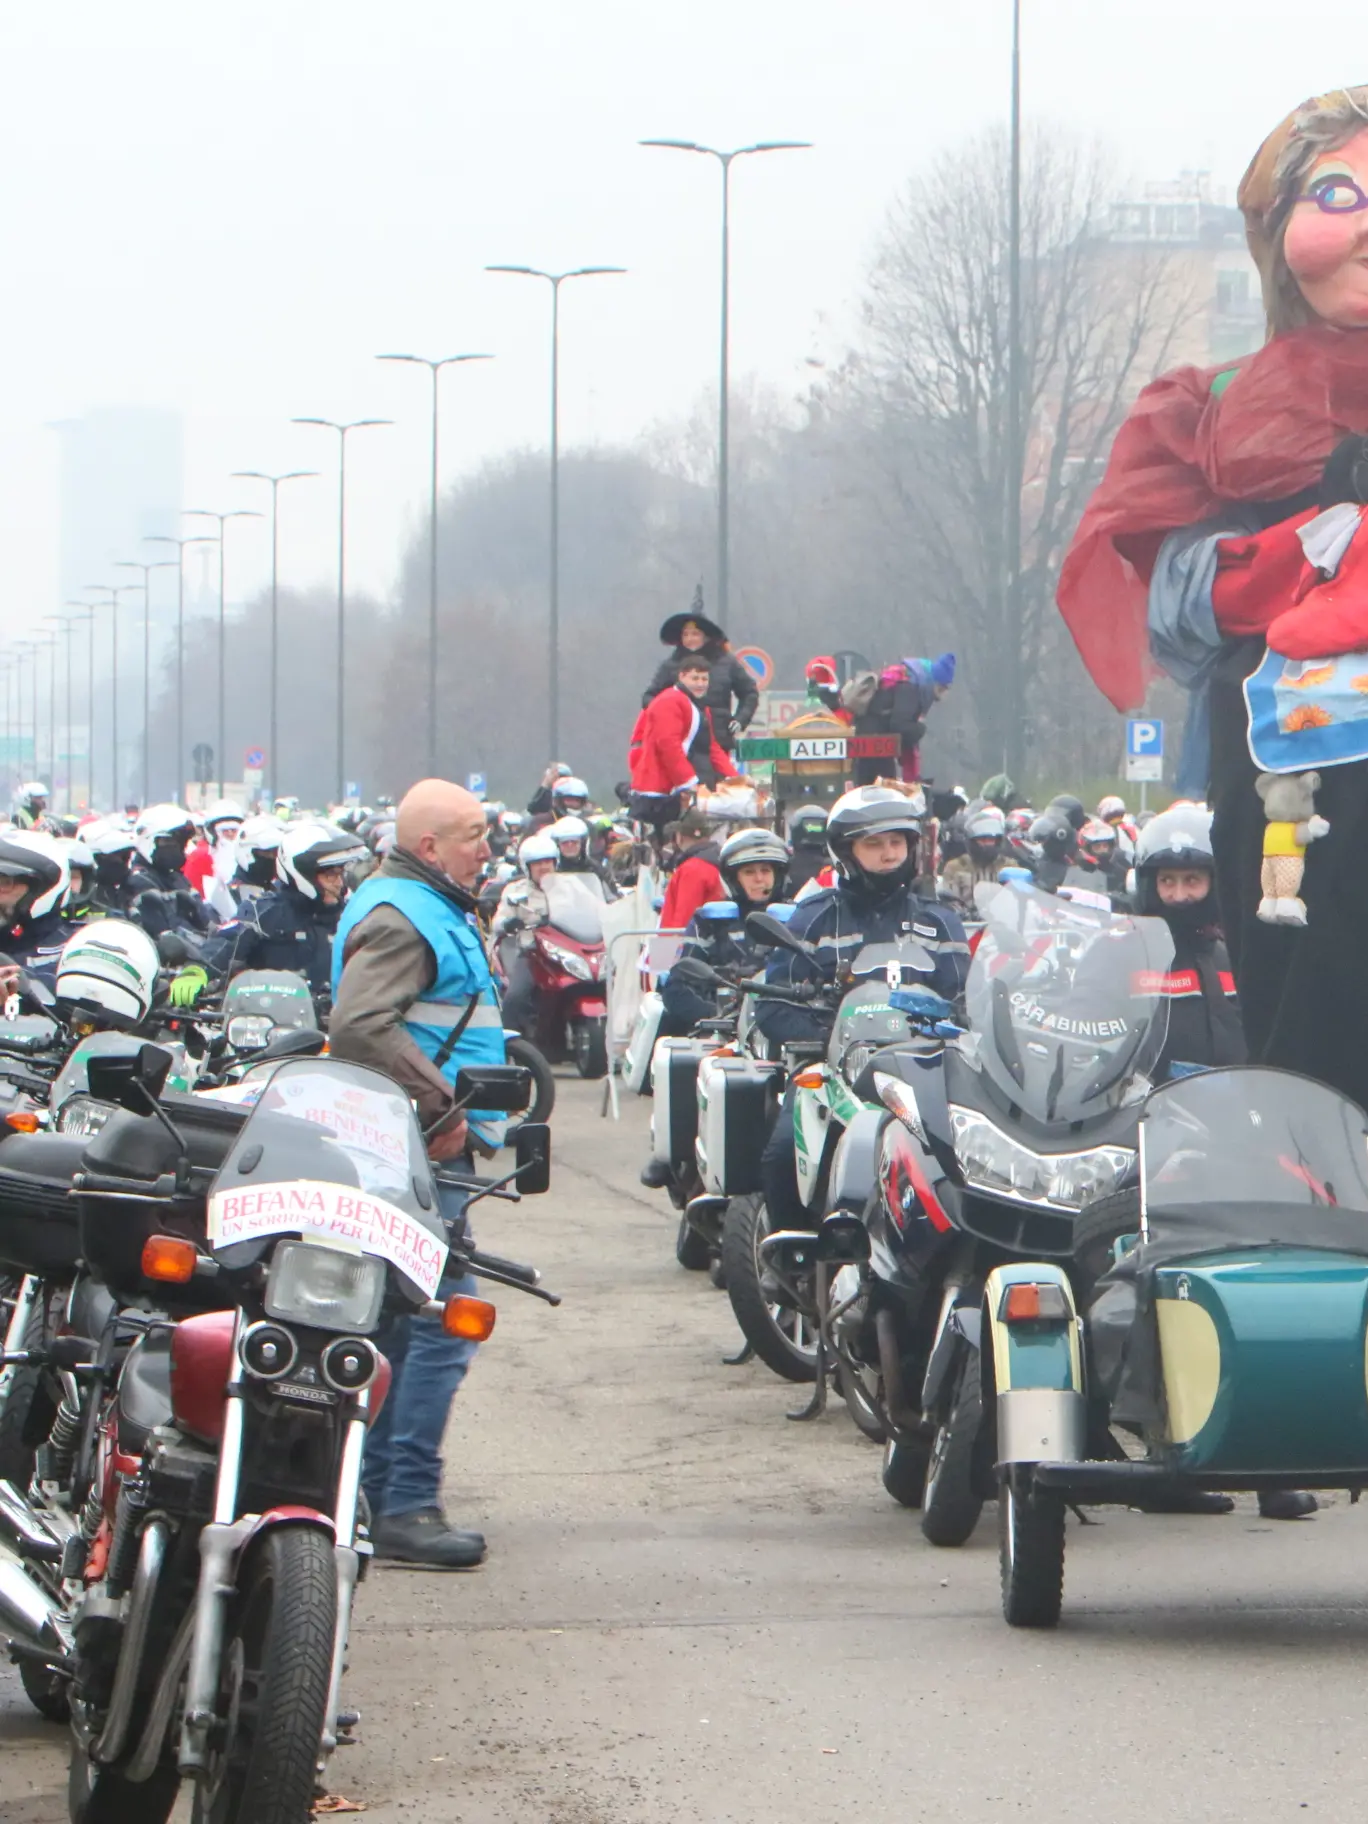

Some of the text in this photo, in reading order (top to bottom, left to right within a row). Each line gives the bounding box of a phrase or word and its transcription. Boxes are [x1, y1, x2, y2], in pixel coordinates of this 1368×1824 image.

[1133, 723, 1156, 753] P
[1010, 992, 1128, 1036] CARABINIERI
[221, 1212, 437, 1290] UN SORRISO PER UN GIORNO
[222, 1189, 441, 1275] BEFANA BENEFICA
[279, 1385, 329, 1402] HONDA
